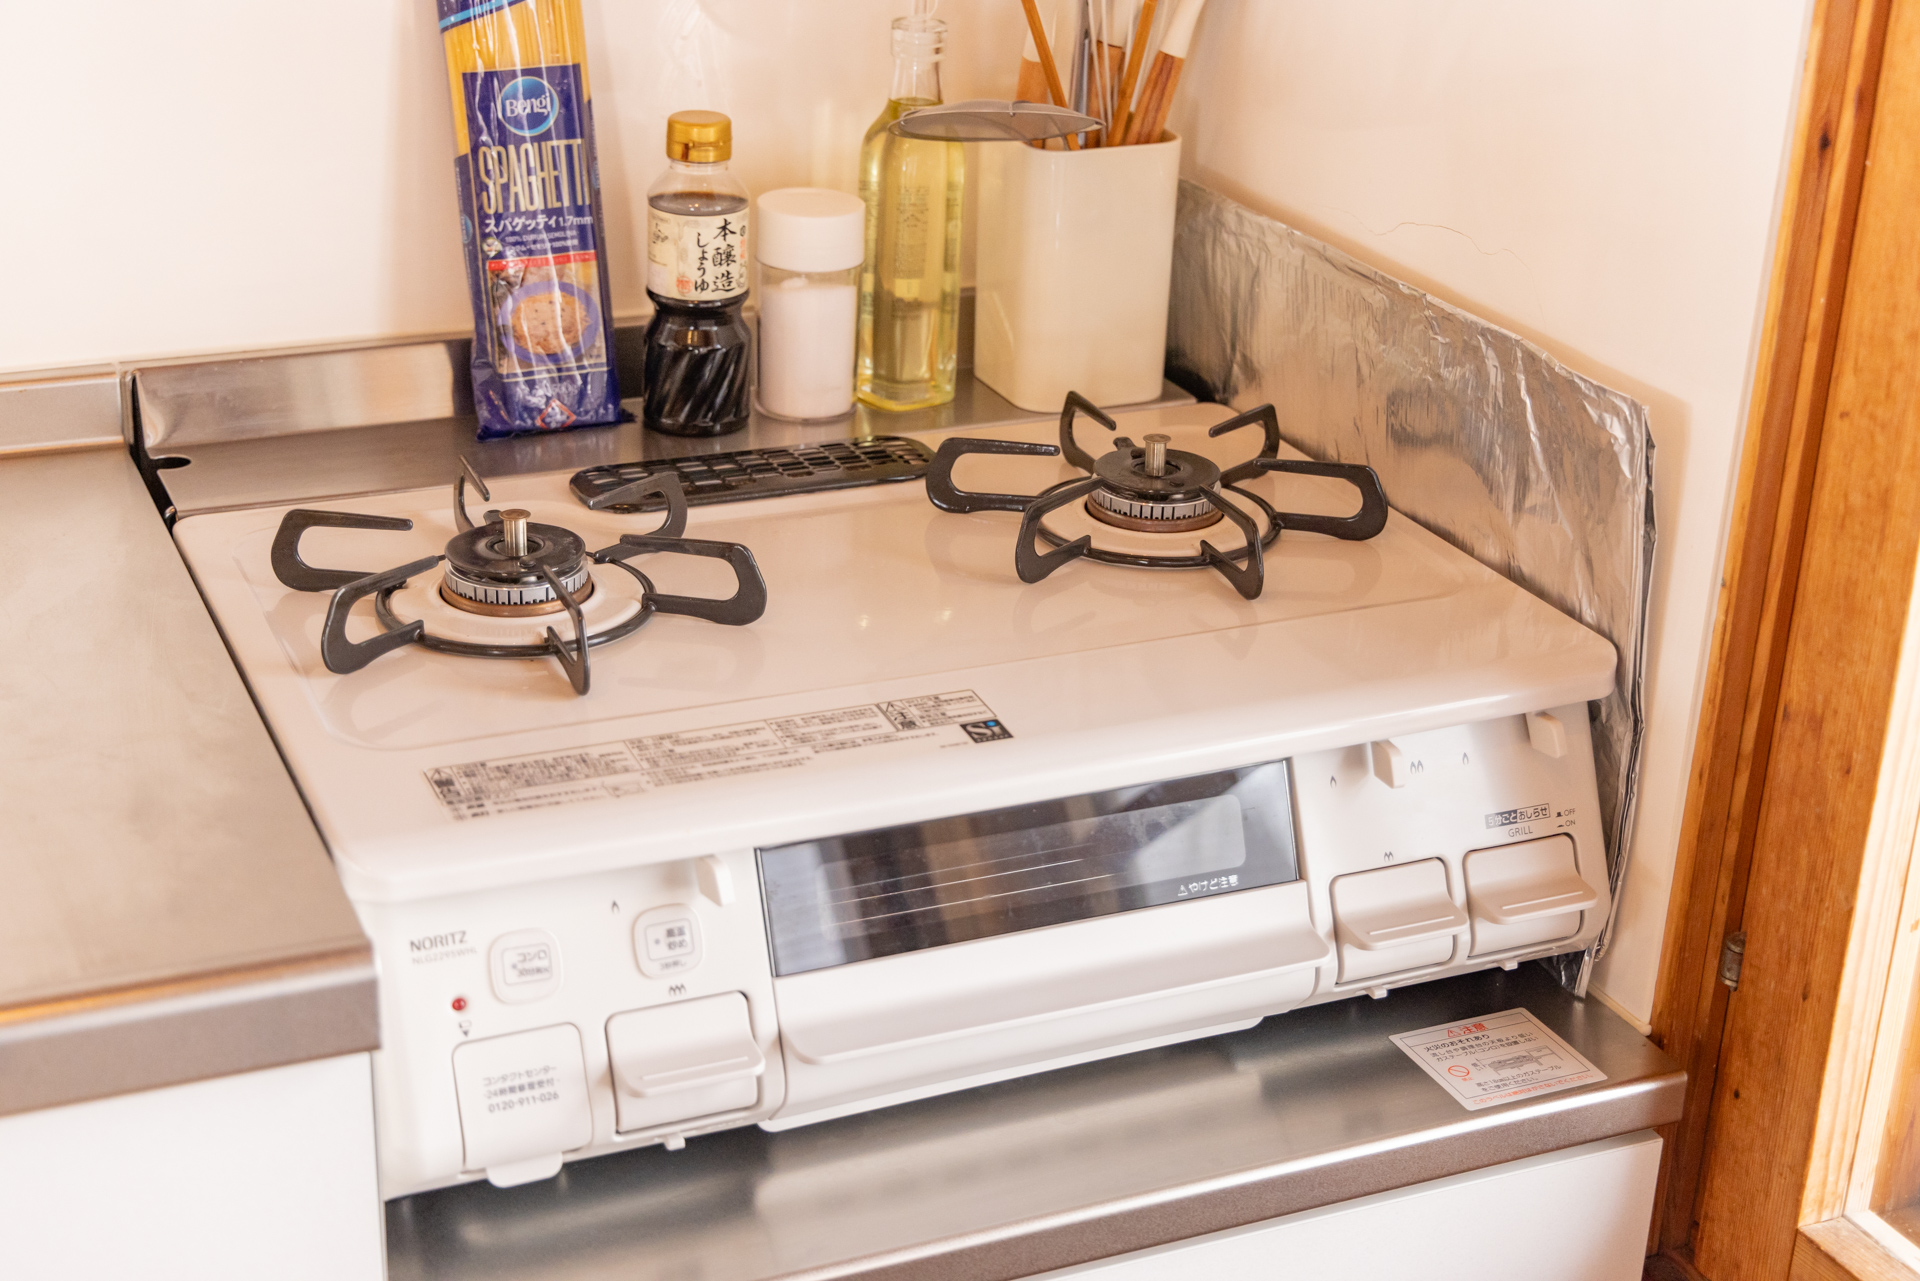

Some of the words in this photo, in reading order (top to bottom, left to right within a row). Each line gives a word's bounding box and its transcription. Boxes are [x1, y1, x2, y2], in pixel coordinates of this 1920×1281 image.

[478, 138, 590, 214] SPAGHETTI
[485, 214, 557, 233] スパゲッティ
[559, 215, 594, 227] 1.7mm
[694, 232, 710, 294] しょうゆ
[1563, 808, 1576, 817] OFF
[1508, 825, 1533, 838] GRILL
[1564, 819, 1576, 827] ON
[1188, 874, 1239, 893] やけど注意
[410, 930, 467, 952] NORITZ
[1462, 1022, 1489, 1035] 注意
[1424, 1033, 1490, 1053] 火災のおそれあり
[483, 1064, 557, 1087] コンタクトセンター
[488, 1091, 560, 1114] 0120-911-026
